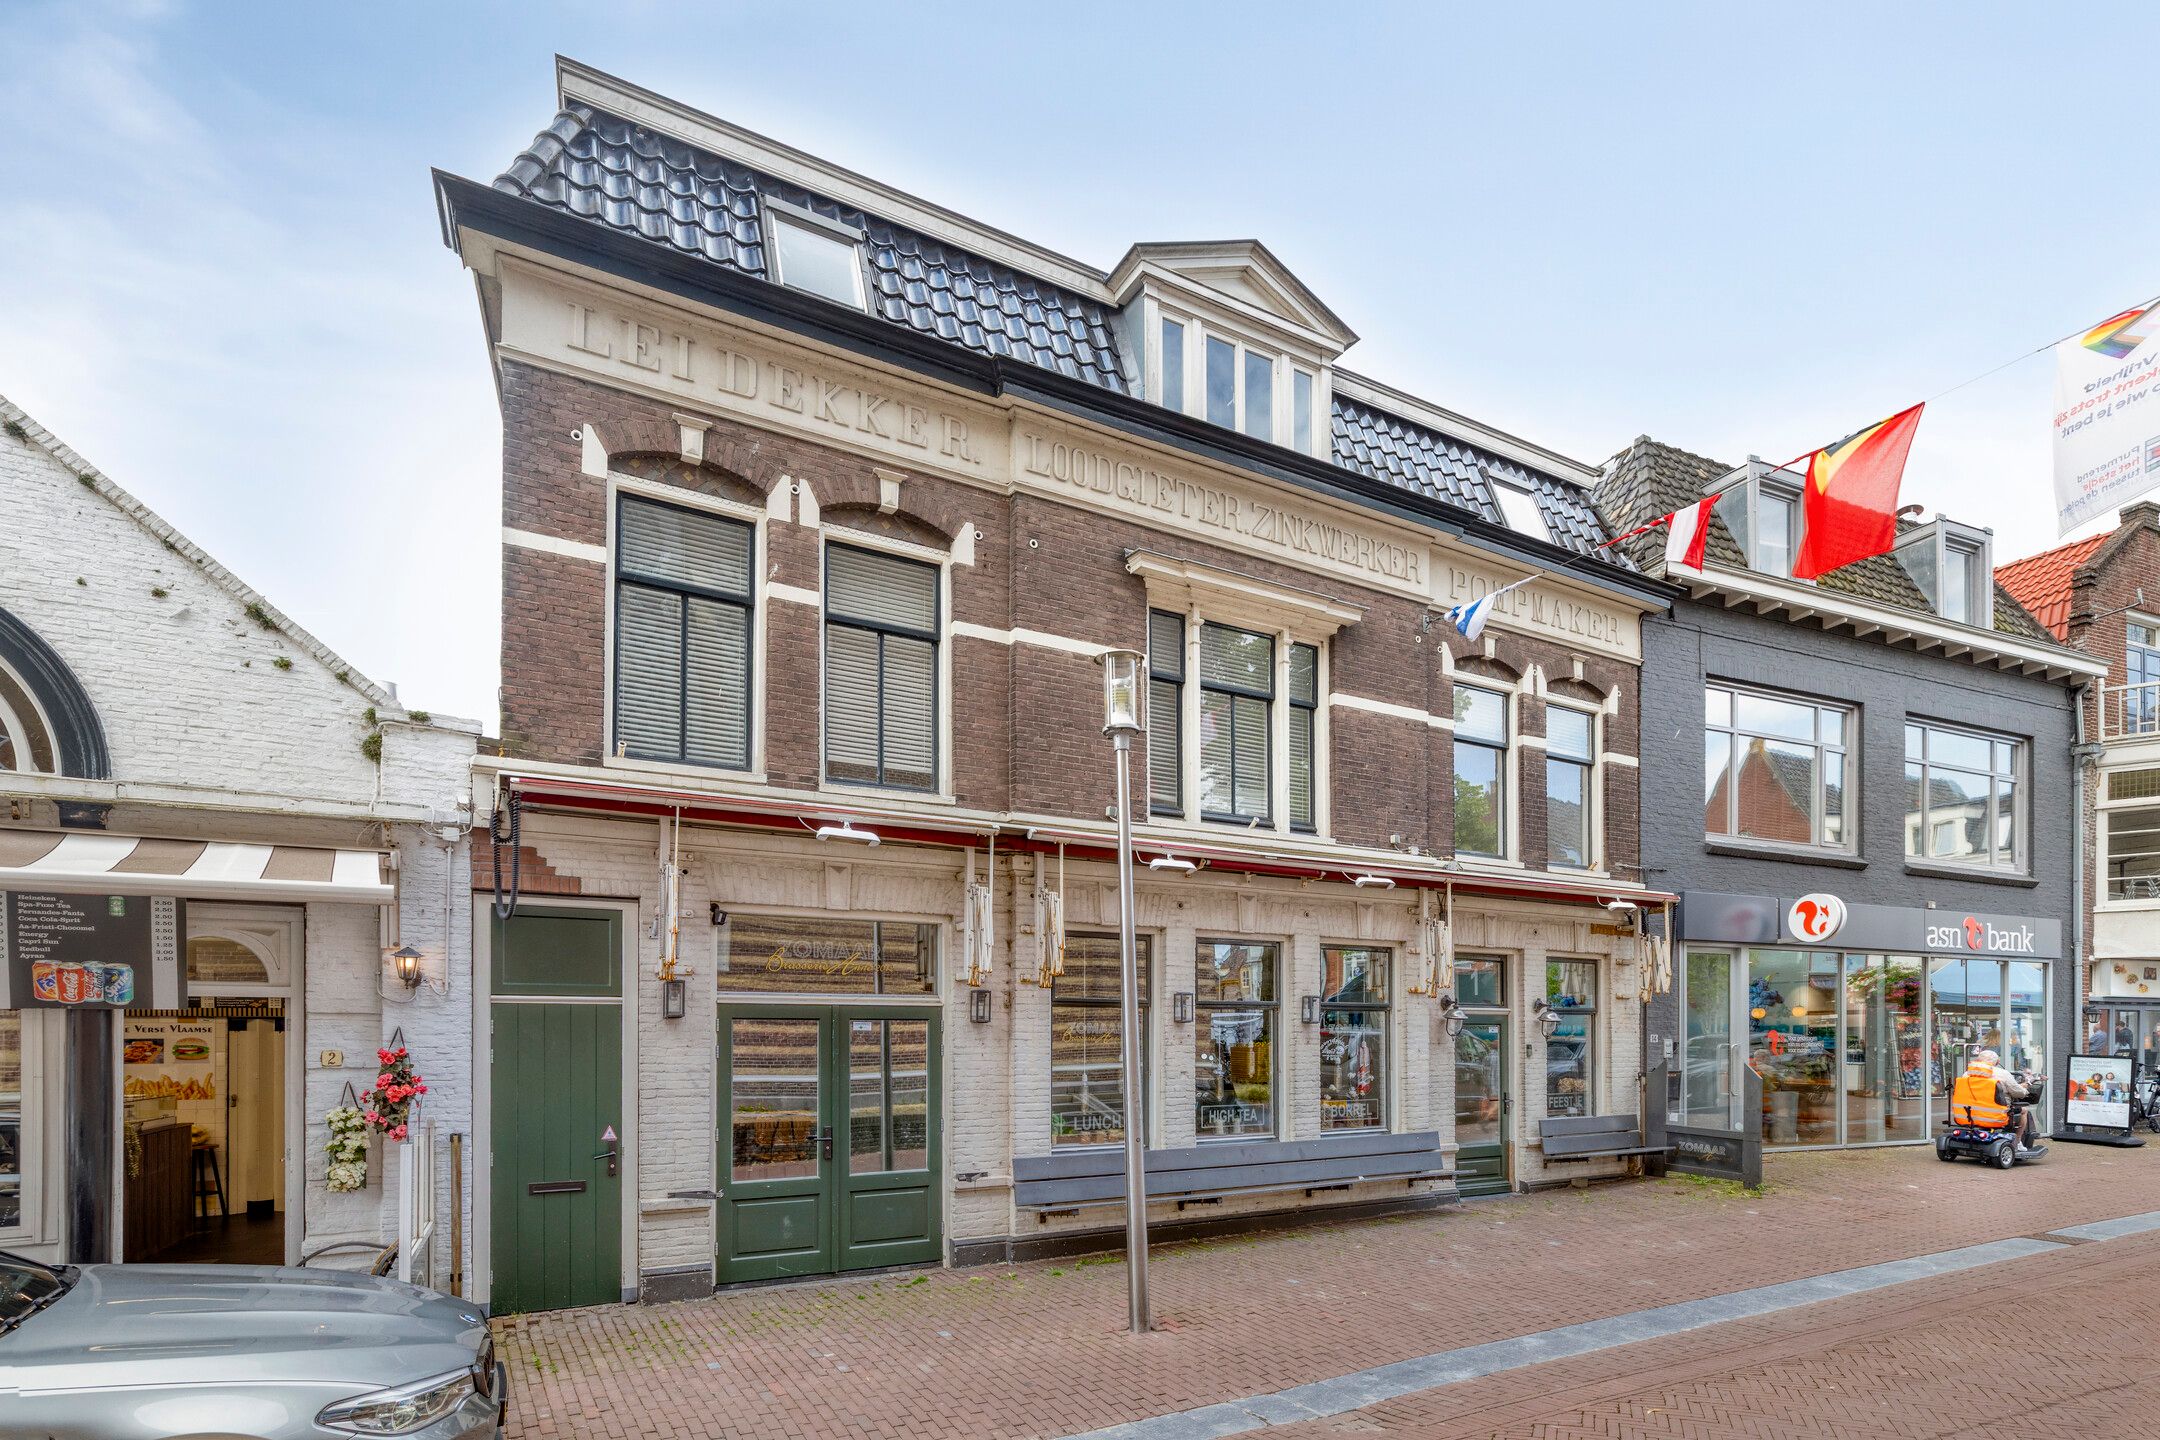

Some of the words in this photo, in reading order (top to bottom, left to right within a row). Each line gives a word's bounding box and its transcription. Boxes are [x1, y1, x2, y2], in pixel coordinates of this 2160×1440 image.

[17, 894, 56, 902] Heineken
[18, 938, 41, 946] Capri
[19, 931, 49, 939] Energy
[1926, 926, 1962, 949] asn
[1987, 922, 2034, 953] bank
[777, 940, 884, 962] ZOMAAR
[327, 1051, 336, 1066] 2
[1548, 1095, 1584, 1108] FEESTJE
[1209, 1109, 1235, 1123] HIGH
[1237, 1107, 1258, 1122] TEA
[1331, 1102, 1373, 1118] BORREL
[1073, 1114, 1123, 1131] LUNCH
[1678, 1140, 1726, 1156] ZOMAAR
